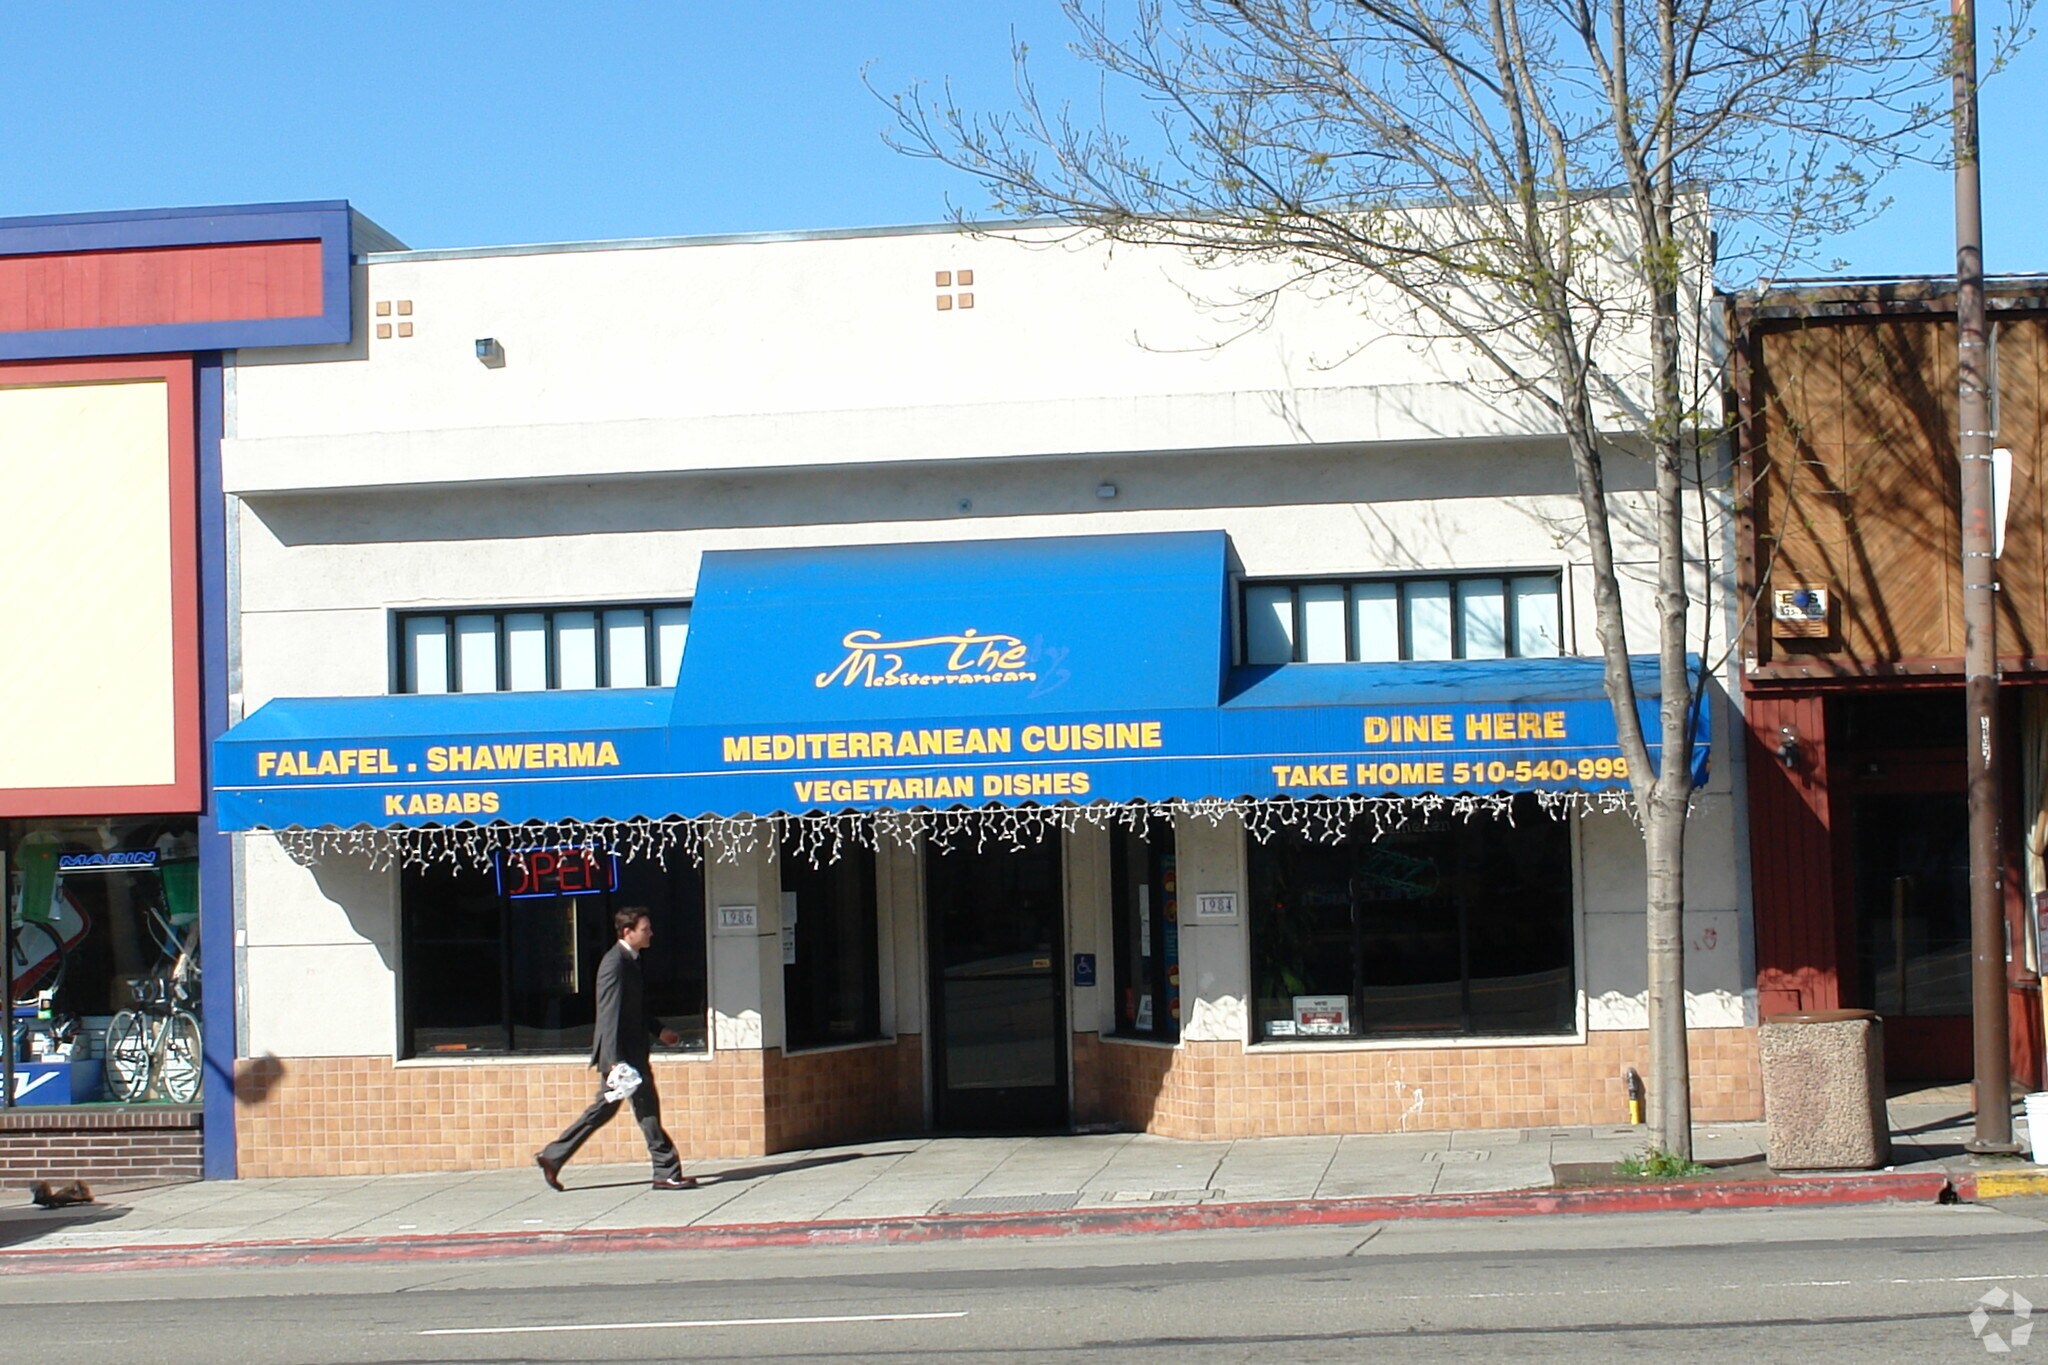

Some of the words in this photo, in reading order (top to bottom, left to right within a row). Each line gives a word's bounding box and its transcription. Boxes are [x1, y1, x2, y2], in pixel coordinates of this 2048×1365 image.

[815, 649, 1037, 688] Mediterranean
[723, 728, 1011, 762] MEDITERRANEAN
[1021, 722, 1163, 753] CUISINE
[1364, 714, 1454, 744] DINE
[1466, 711, 1567, 741] HERE
[257, 749, 398, 777] FALAFEL
[426, 741, 620, 772] SHAWERMA
[1272, 763, 1349, 787] TAKE
[1357, 761, 1445, 786] HOME
[1453, 756, 1631, 784] 510-540-999
[794, 775, 975, 803] VEGETARIAN
[983, 772, 1091, 797] DISHES
[385, 792, 500, 816] KABABS
[59, 851, 156, 866] MARIN
[722, 911, 753, 925] 1986
[1202, 899, 1233, 912] 1984
